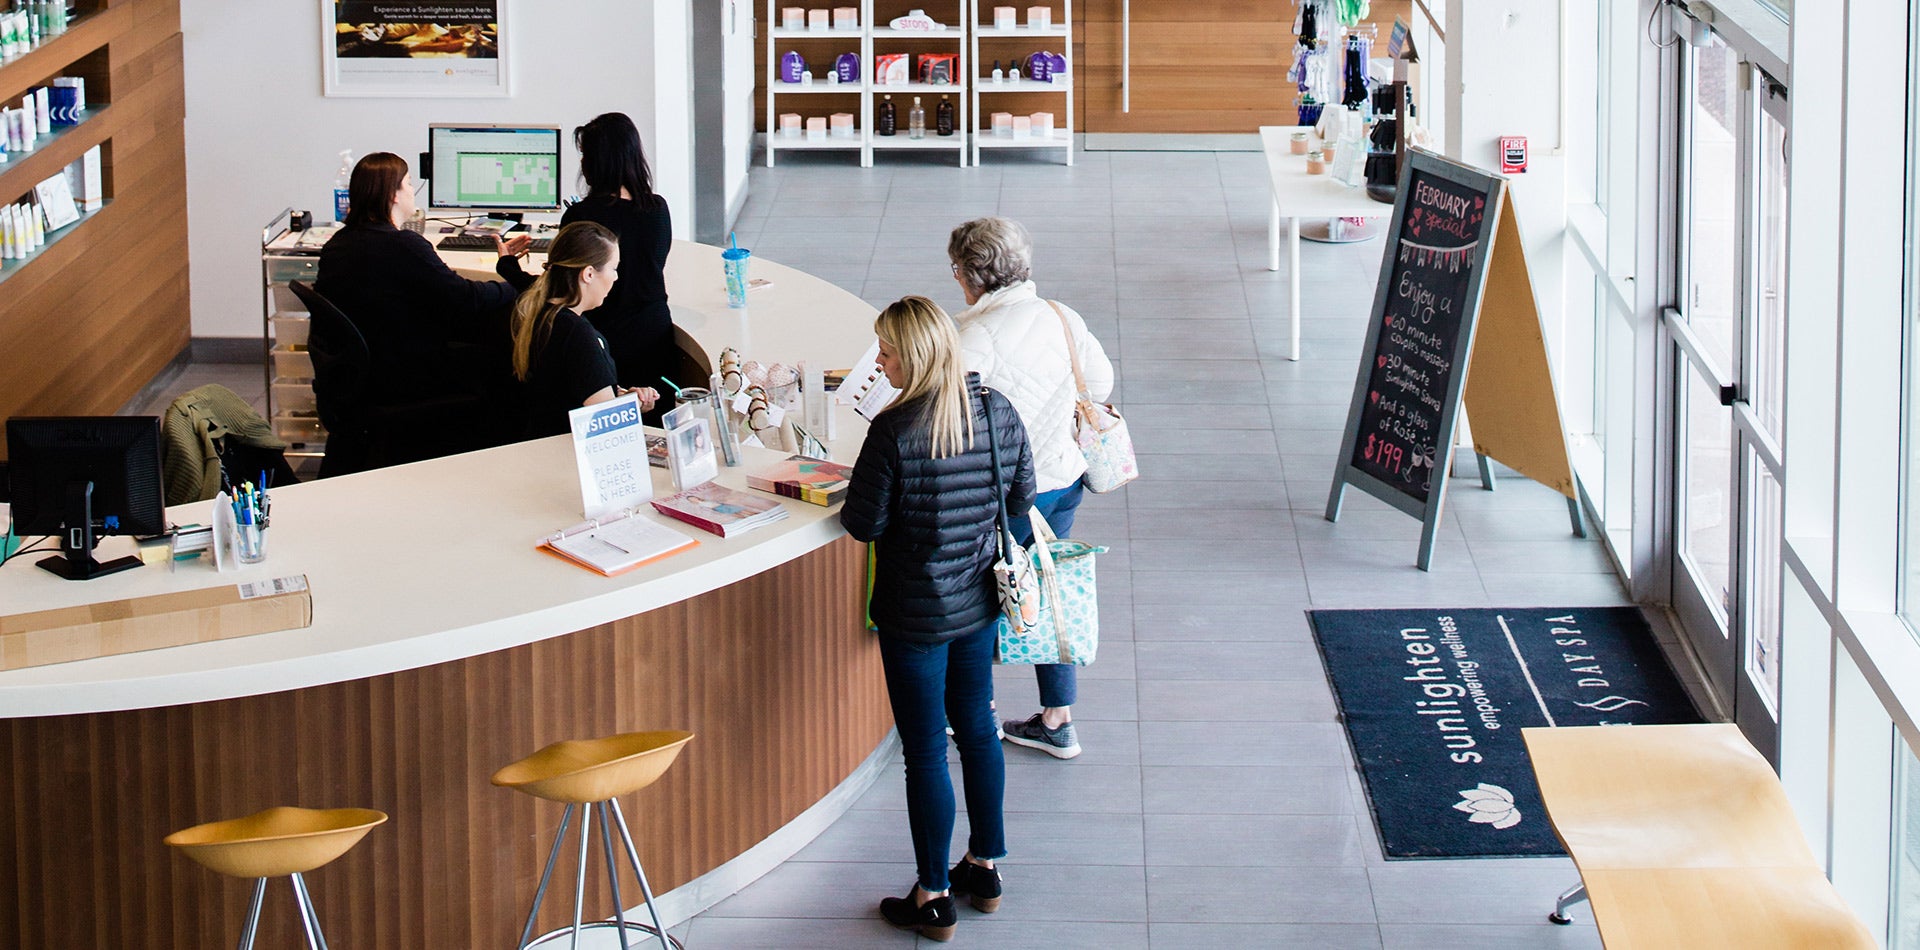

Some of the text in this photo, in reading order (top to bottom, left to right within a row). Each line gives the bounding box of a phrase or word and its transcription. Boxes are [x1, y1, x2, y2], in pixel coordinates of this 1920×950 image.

[373, 6, 410, 14] Experience
[418, 6, 453, 14] Sunlighten
[900, 18, 929, 31] strong
[1504, 140, 1525, 148] FIRE
[1415, 180, 1471, 219] FEBRUARY
[1399, 270, 1451, 324] Enjoy a
[1391, 313, 1442, 350] 60 minute
[1386, 353, 1430, 386] 30 minute
[1420, 349, 1450, 375] massage
[1379, 395, 1429, 430] And a glass
[1379, 416, 1392, 432] of
[593, 458, 632, 479] PLEASE
[1364, 433, 1403, 474] $199
[599, 472, 635, 490] CHECK
[1544, 614, 1610, 687] DAY SPA
[1438, 616, 1501, 730] empowering wellness
[1400, 628, 1483, 764] sunlighten
